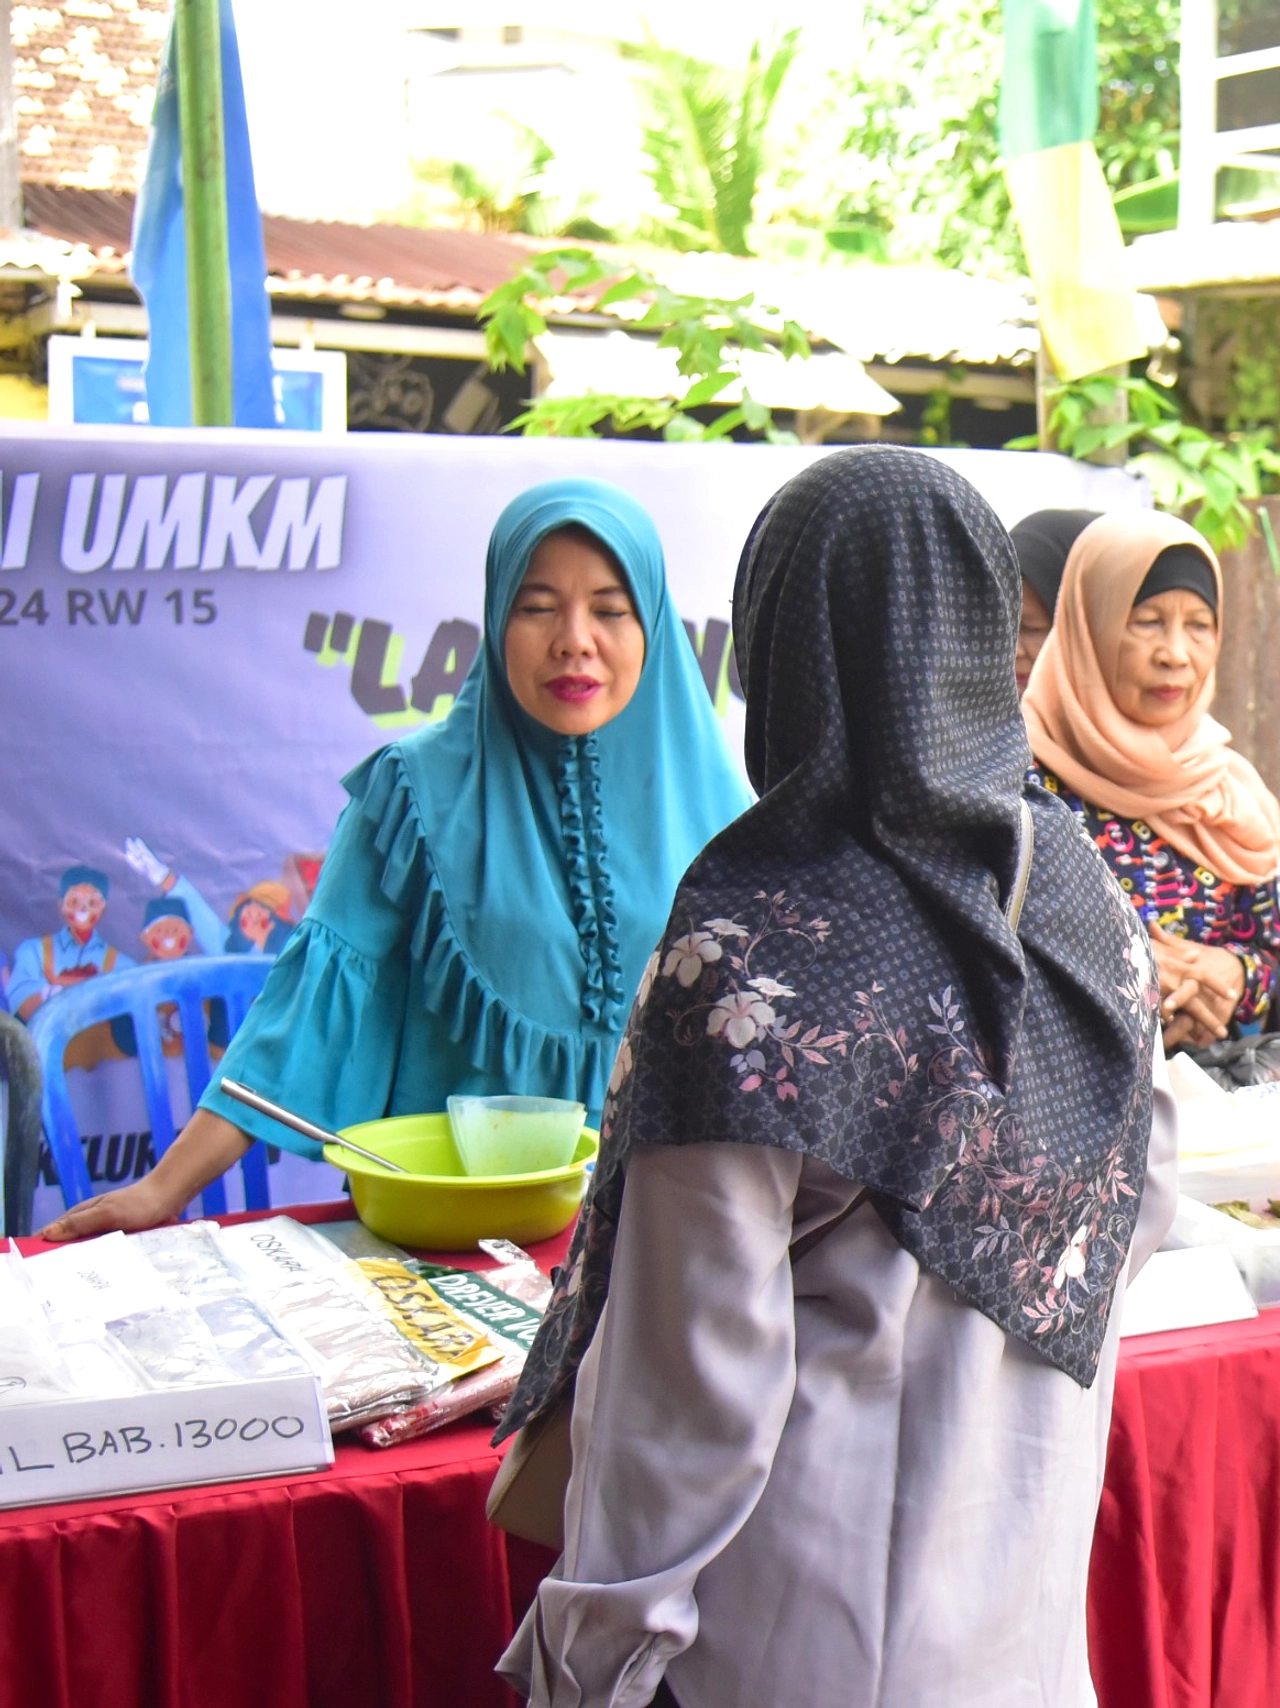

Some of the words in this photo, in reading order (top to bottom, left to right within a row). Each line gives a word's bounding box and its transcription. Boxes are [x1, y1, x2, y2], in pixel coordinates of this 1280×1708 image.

[60, 472, 348, 573] UMKM
[0, 588, 49, 627] 24
[67, 588, 147, 627] RW
[164, 588, 218, 627] 15
